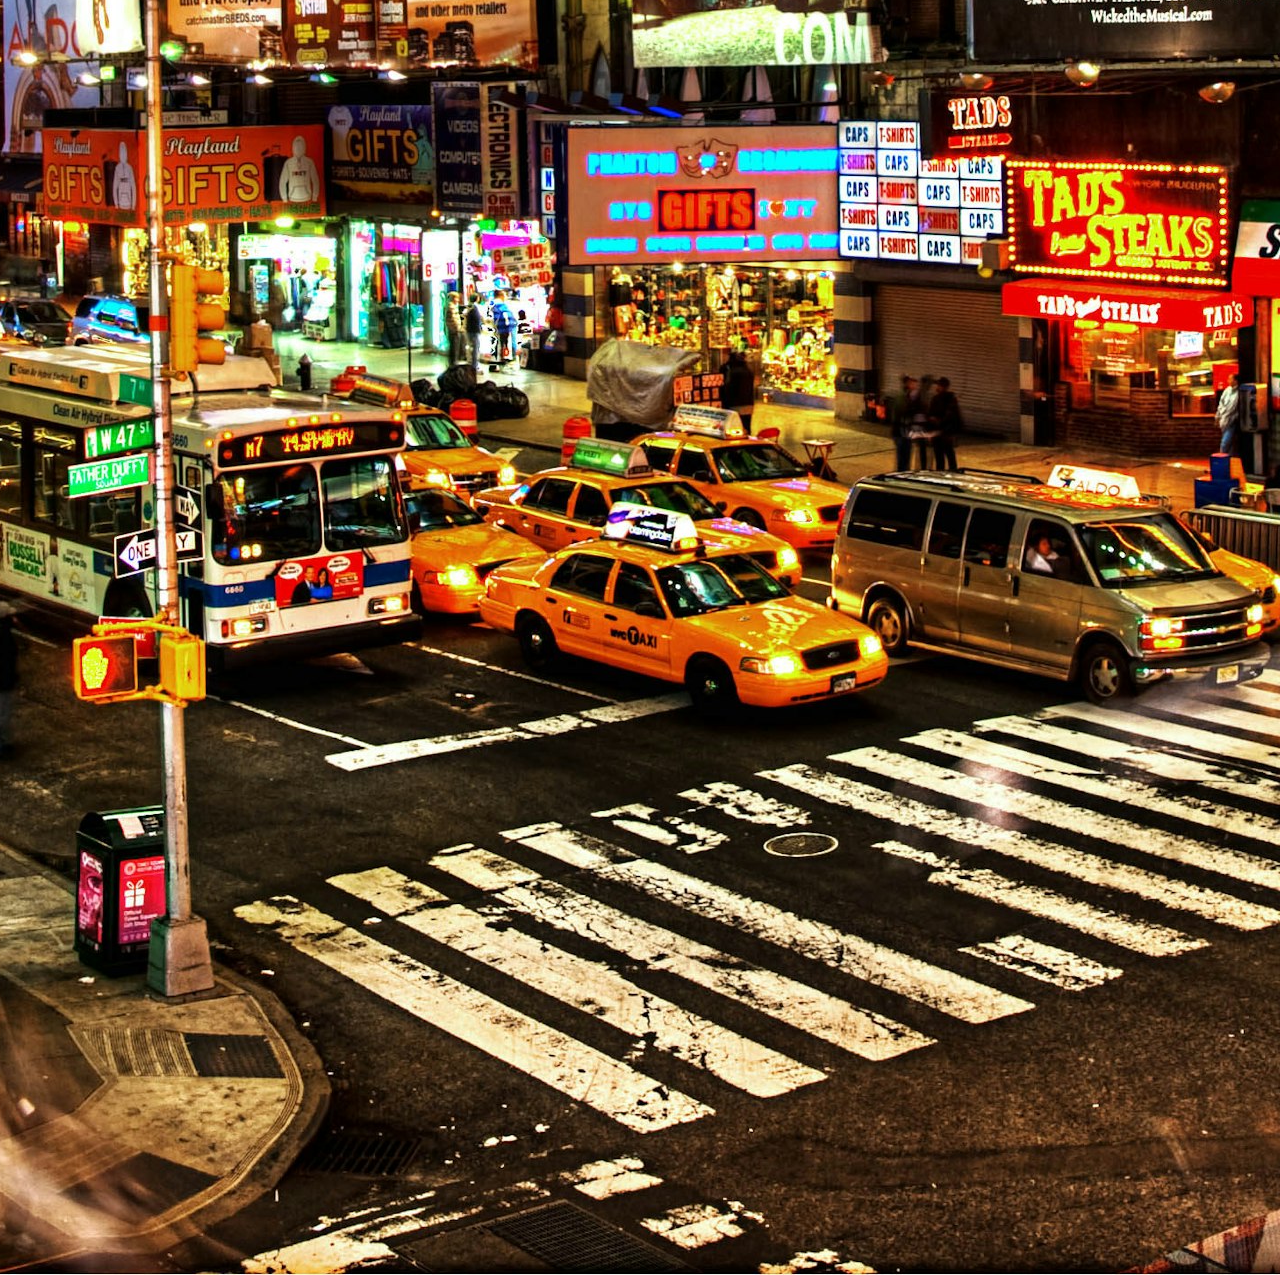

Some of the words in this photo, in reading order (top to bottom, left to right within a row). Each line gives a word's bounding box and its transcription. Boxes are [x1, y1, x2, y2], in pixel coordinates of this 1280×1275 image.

[429, 4, 450, 17] other
[1091, 7, 1213, 24] WickedtheMusical.com
[359, 106, 401, 124] Playland
[948, 96, 1013, 130] TADS
[447, 120, 479, 133] VIDEOS
[845, 127, 868, 143] CAPS
[879, 128, 915, 144] T-SHIRTS
[165, 134, 240, 159] Playland
[345, 127, 419, 166] GIFTS
[841, 154, 875, 170] T-SHIRTS
[885, 155, 908, 171] CAPS
[46, 164, 102, 204] GIFTS
[846, 182, 869, 197] CAPS
[879, 182, 916, 199] T-SHIRTS
[926, 185, 950, 201] CAPS
[962, 186, 1000, 203] T-SHIRTS
[1024, 170, 1125, 227] TAD'S
[660, 191, 753, 230] GIFTS
[842, 208, 876, 225] T-SHIRTS
[886, 211, 909, 226] CAPS
[921, 212, 958, 230] T-SHIRTS
[969, 213, 994, 229] CAPS
[847, 236, 870, 251] CAPS
[880, 237, 916, 254] T-SHIRTS
[927, 241, 952, 257] CAPS
[1087, 213, 1214, 268] STEAKS
[1101, 302, 1161, 324] STEAKS
[1203, 300, 1243, 328] TAD'S
[101, 429, 112, 451] W
[116, 424, 135, 447] 47
[139, 420, 150, 434] ST
[70, 464, 111, 486] FATHER
[113, 458, 146, 479] DUFFY
[1074, 480, 1121, 498] ALDO
[180, 496, 195, 517] WAY
[127, 543, 151, 562] ONE
